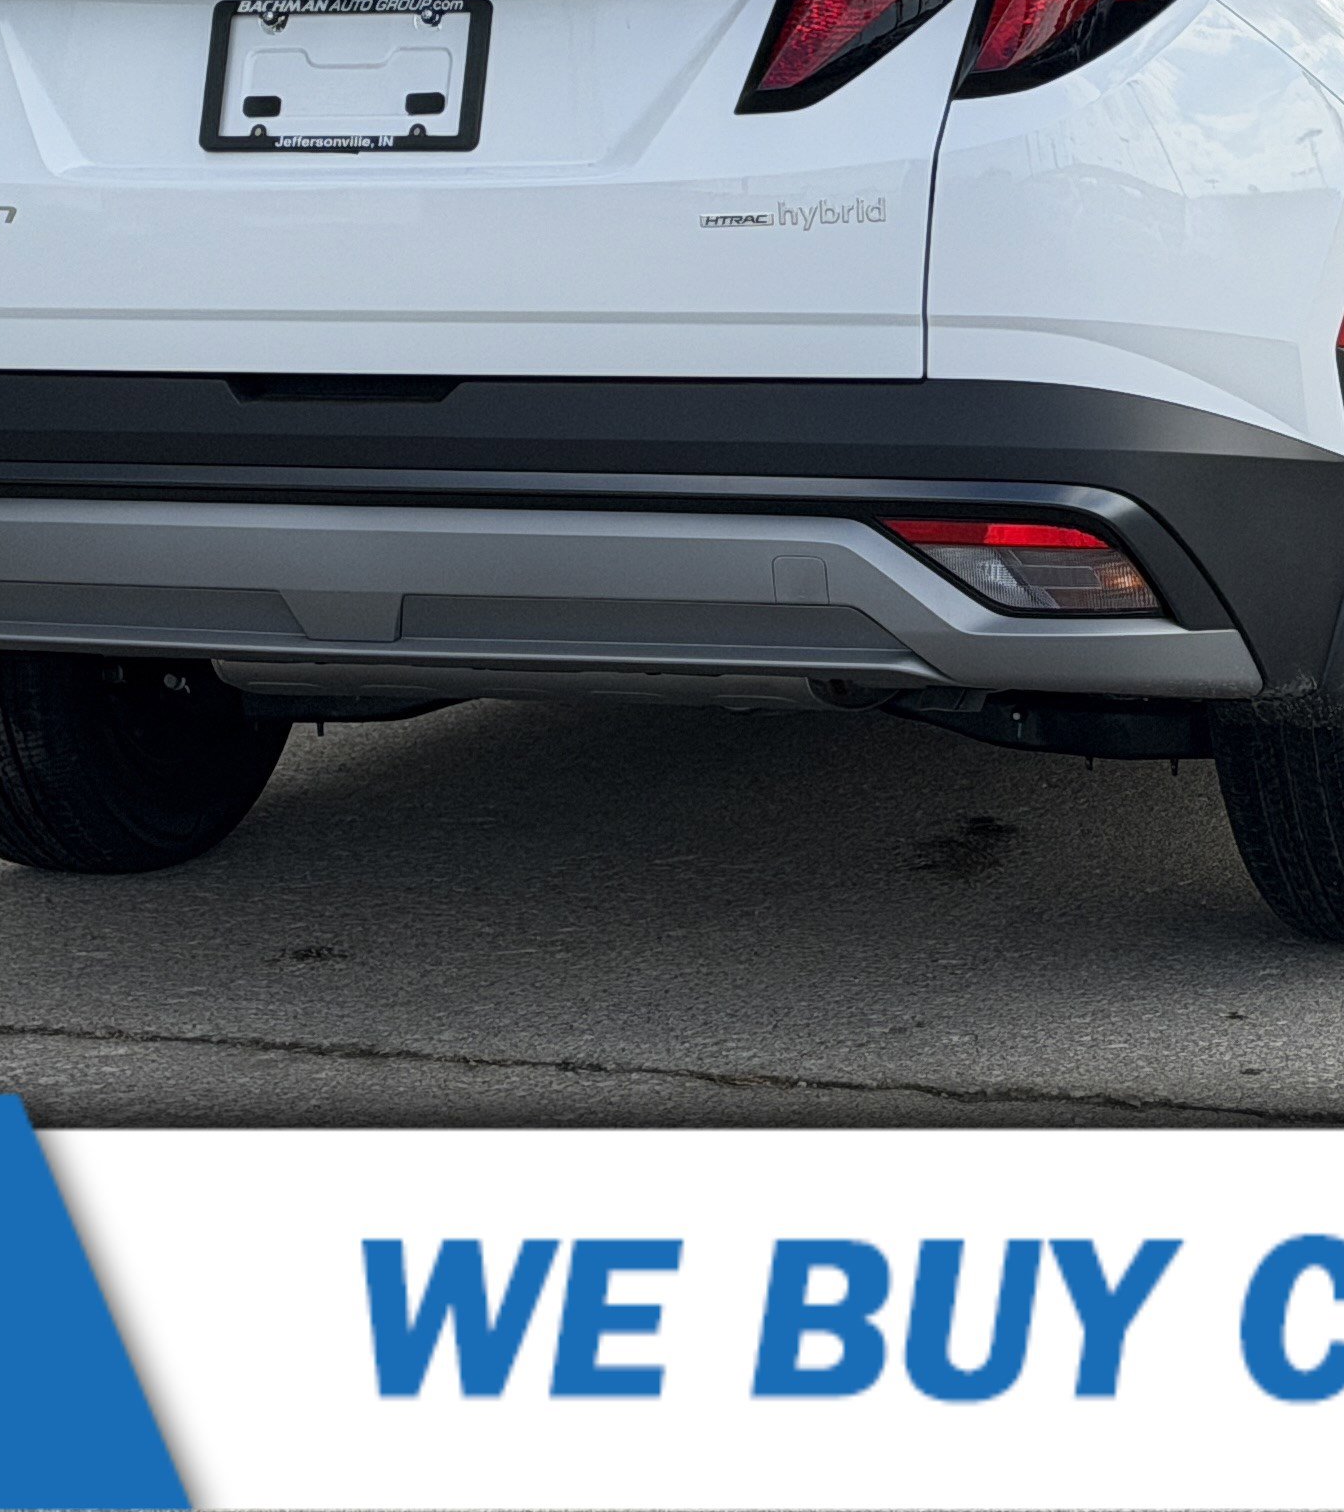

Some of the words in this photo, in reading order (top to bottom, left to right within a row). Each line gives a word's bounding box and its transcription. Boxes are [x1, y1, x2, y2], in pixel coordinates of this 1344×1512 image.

[237, 0, 329, 13] BACHMAN
[275, 135, 374, 148] Jeffersonville,
[377, 135, 394, 147] IN
[705, 214, 769, 225] HTRAC
[777, 197, 887, 231] hybrid
